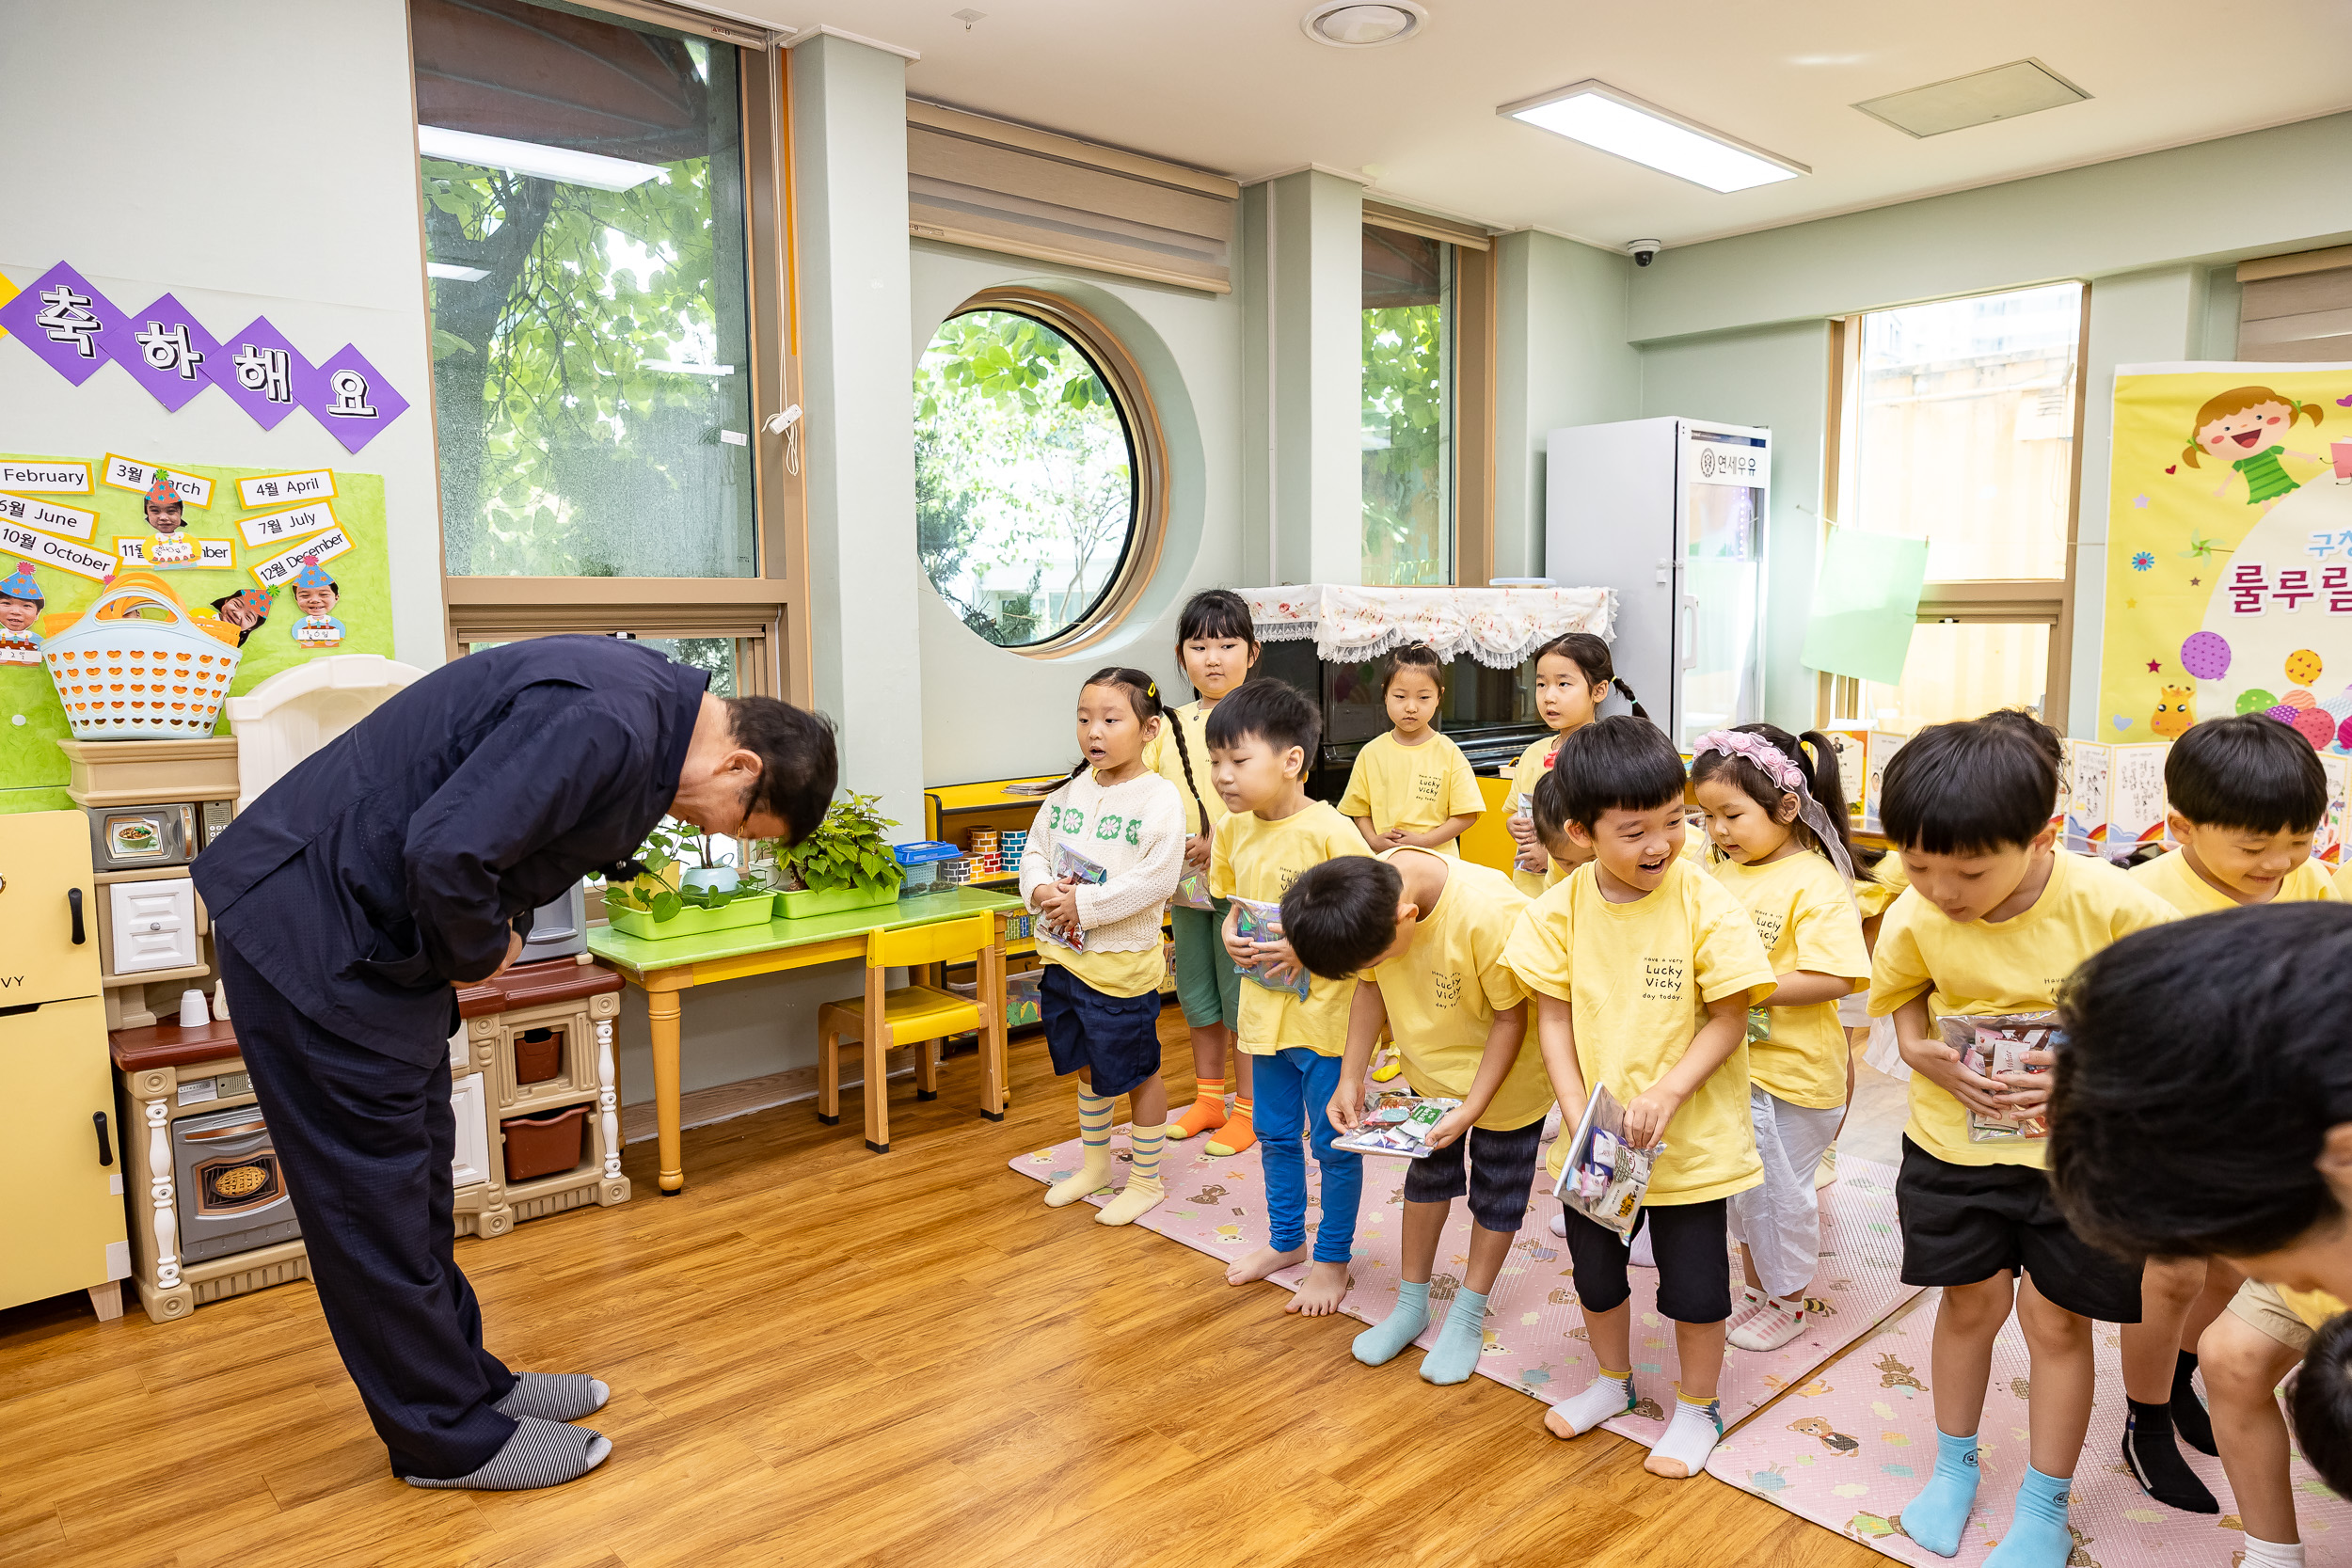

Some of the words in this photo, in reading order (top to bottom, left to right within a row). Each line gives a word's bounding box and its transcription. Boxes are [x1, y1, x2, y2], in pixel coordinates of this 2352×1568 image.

[35, 285, 379, 419] 축하해요
[117, 465, 143, 483] 3월
[1718, 455, 1756, 476] 연세우유
[4, 468, 85, 486] February
[256, 482, 279, 497] 4월
[287, 478, 320, 495] April
[34, 508, 77, 528] June
[258, 518, 283, 534] 7월
[290, 513, 315, 528] July
[3, 529, 37, 550] 10월
[43, 542, 111, 572] October
[260, 562, 288, 581] 12월
[1419, 787, 1438, 797] Vicky
[1420, 780, 1440, 789] Lucky
[1646, 965, 1682, 978] Lucky
[1645, 978, 1681, 991] Vicky
[1642, 992, 1656, 1001] day
